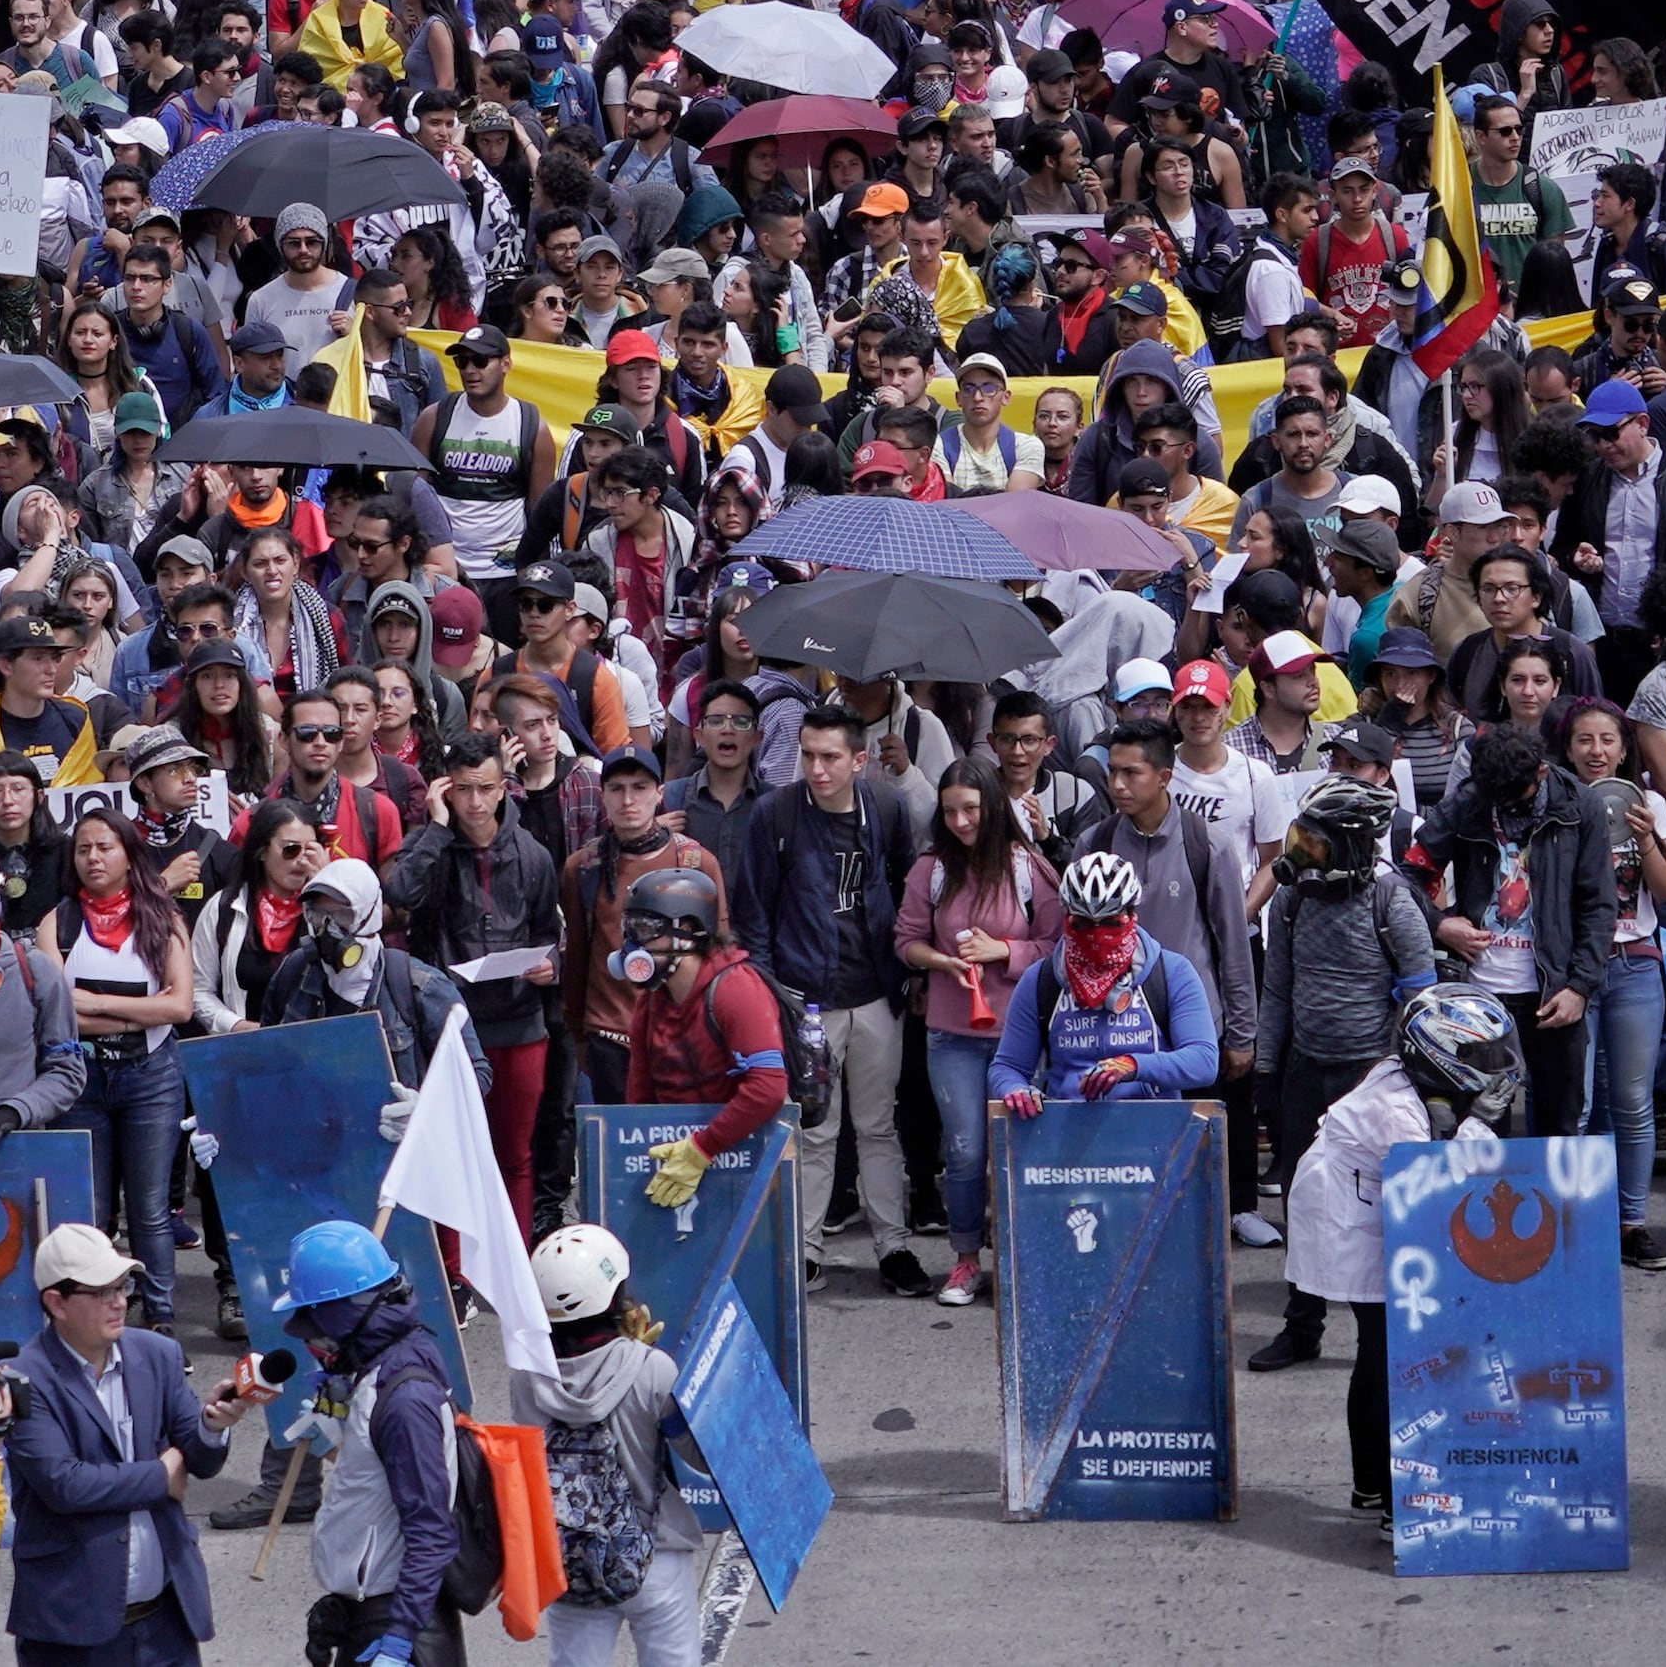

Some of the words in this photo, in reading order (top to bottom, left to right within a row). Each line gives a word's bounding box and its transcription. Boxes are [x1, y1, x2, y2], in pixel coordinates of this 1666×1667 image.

[1543, 112, 1583, 128] ADORO
[1595, 108, 1612, 122] EL
[1618, 104, 1645, 121] OLOR
[1653, 102, 1661, 116] A
[1600, 125, 1615, 138] EN
[1619, 123, 1632, 134] LA
[285, 309, 306, 317] START
[310, 307, 330, 316] NOW
[444, 451, 512, 473] GOLEADOR
[1065, 1017, 1097, 1032] SURF
[1108, 1015, 1141, 1026] CLUB
[619, 1126, 644, 1145] LA
[625, 1154, 650, 1173] SE
[1547, 1135, 1612, 1198] UD
[1024, 1167, 1155, 1185] RESISTENCIA
[1566, 1410, 1611, 1423] LUTTER
[1397, 1411, 1440, 1444] LUTTER
[1078, 1430, 1103, 1449] LA
[1108, 1430, 1215, 1451] PROTESTA
[1447, 1449, 1579, 1466] RESISTENCIA
[1082, 1458, 1108, 1477] SE
[1114, 1458, 1212, 1477] DEFIENDE
[1566, 1507, 1611, 1520] LUTTER
[1404, 1518, 1448, 1537] LUTTER
[1476, 1517, 1517, 1531] LUTTER
